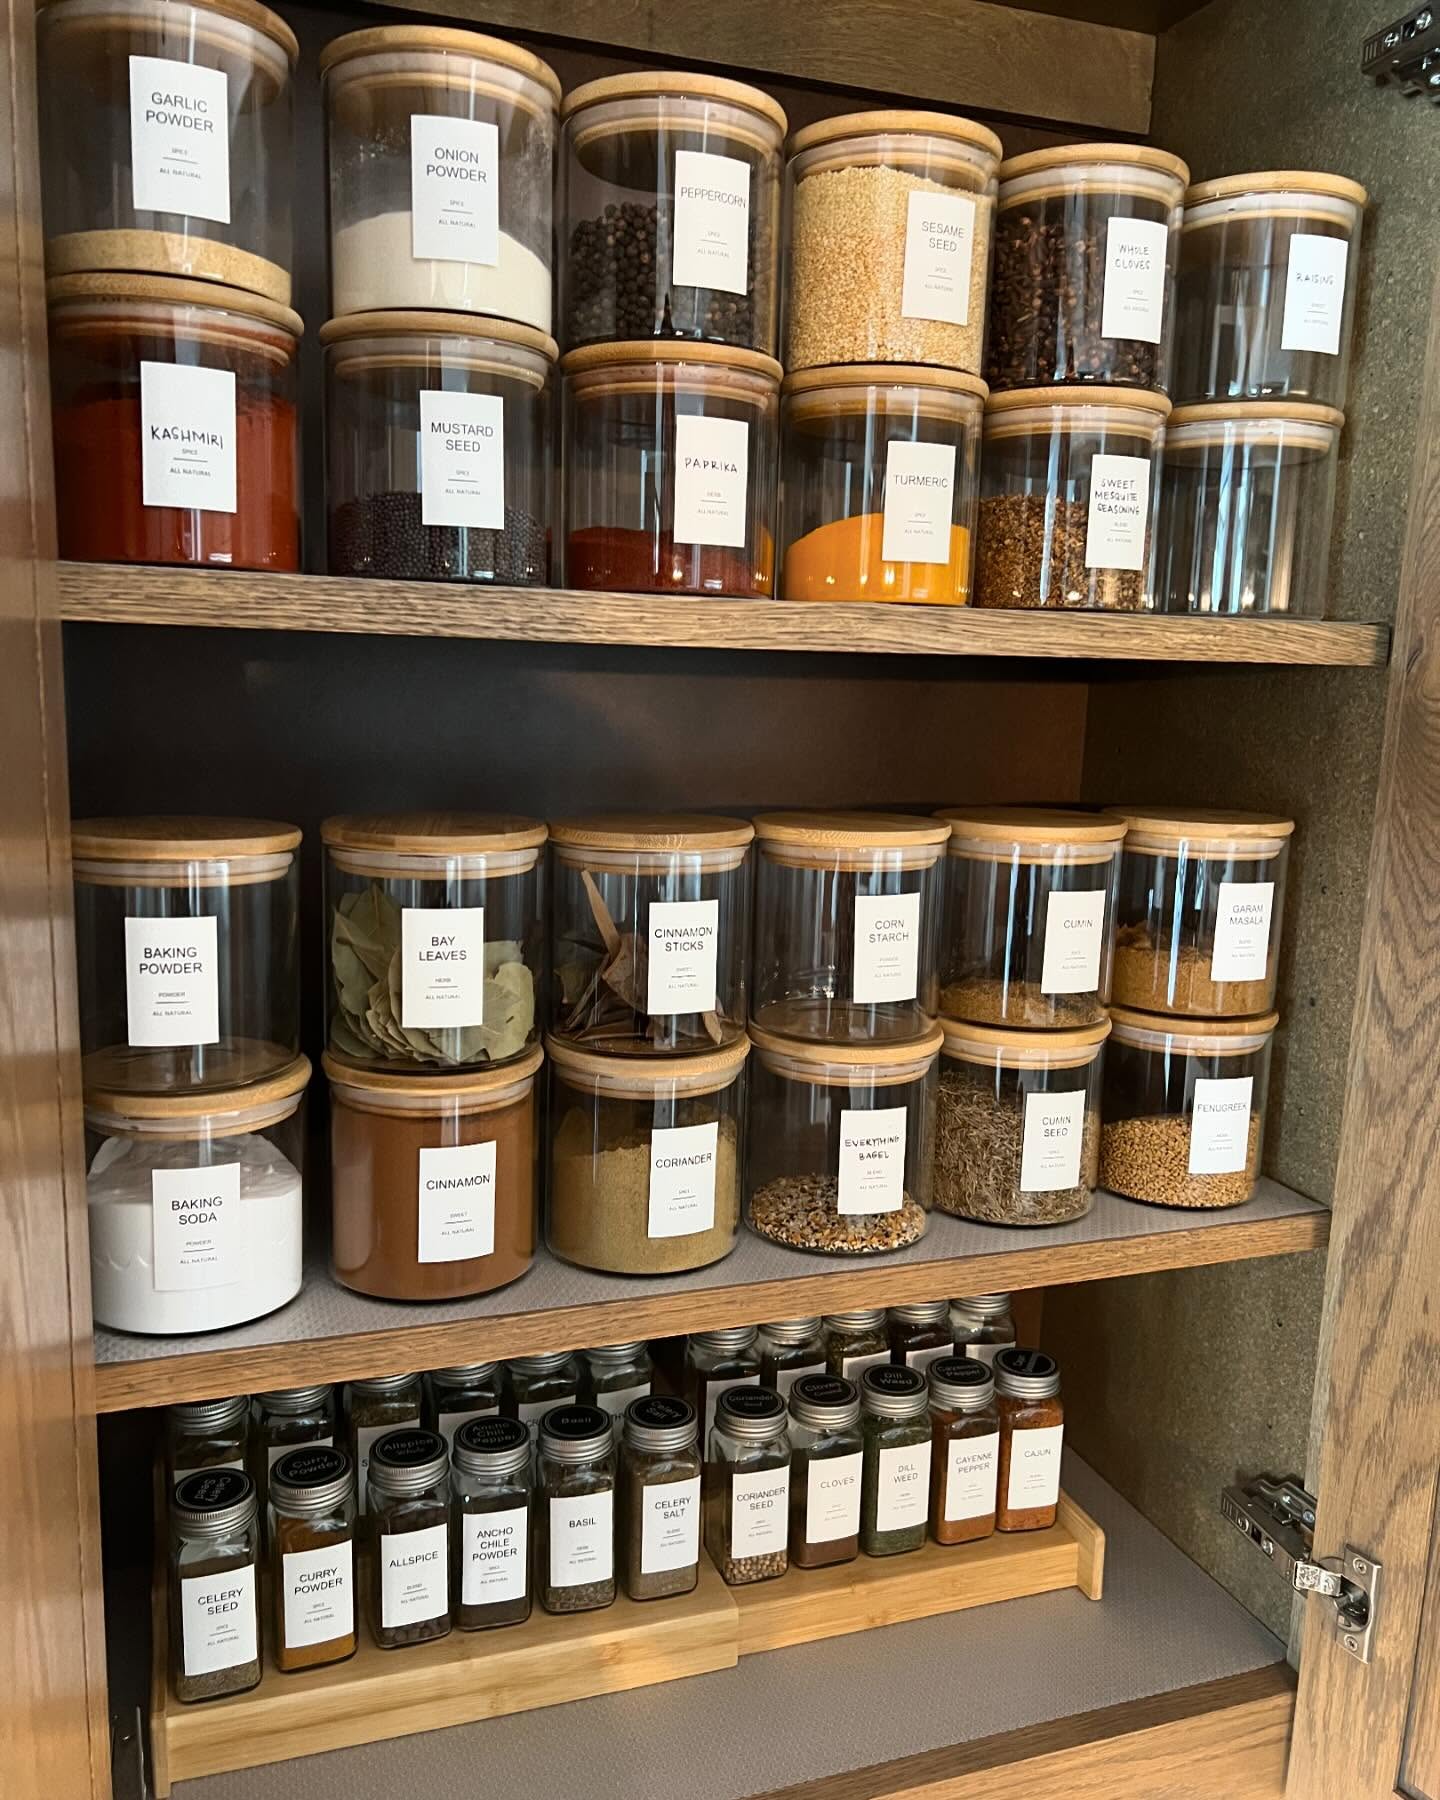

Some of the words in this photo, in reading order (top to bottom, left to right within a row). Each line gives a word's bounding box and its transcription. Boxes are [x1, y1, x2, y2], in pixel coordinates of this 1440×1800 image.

[151, 92, 207, 113] GARLIC
[146, 110, 213, 132] POWDER
[434, 147, 479, 164] ONION
[426, 164, 487, 182] POWDER
[681, 187, 746, 208] PEPPERCORN
[921, 221, 965, 238] SESAME
[929, 237, 957, 252] SEED
[1120, 244, 1149, 255] WHOLE
[1115, 258, 1150, 270] CLOVES
[431, 422, 493, 437] MUSTARD
[151, 425, 223, 449] KASHMIRI
[446, 439, 480, 452] SEED
[685, 457, 737, 473] PAPRIKA
[183, 469, 211, 477] NATURAL
[895, 474, 948, 488] TURMERIC
[1101, 479, 1135, 489] SWEET
[1095, 490, 1137, 501] MESQUITE
[1232, 904, 1263, 913] GARAM
[875, 919, 904, 930] CORN
[1063, 919, 1092, 929] CUMIN
[1229, 917, 1263, 925] MASALA
[654, 926, 712, 938] CINNAMON
[869, 932, 909, 943] STARCH
[431, 936, 455, 946] BAY
[665, 941, 704, 952] STICKS
[144, 946, 197, 958] BAKING
[419, 950, 467, 961] LEAVES
[139, 962, 202, 975] POWDER
[1197, 1103, 1247, 1112] FENUGREEK
[1042, 1116, 1071, 1125] CUMIN
[1044, 1127, 1068, 1137] SEED
[844, 1135, 900, 1147] EVERYTHING
[655, 1152, 712, 1168] CORIANDER
[859, 1151, 889, 1161] BAGEL
[426, 1173, 490, 1190] CINNAMON
[171, 1196, 222, 1210] BAKING
[178, 1212, 217, 1225] SODA
[383, 1438, 433, 1451] Allspice
[955, 1452, 992, 1464] CAYENNE
[1024, 1449, 1050, 1458] CAJUN
[292, 1455, 328, 1469] Curry
[898, 1464, 915, 1472] DILL
[958, 1462, 989, 1473] PEPPER
[289, 1460, 337, 1478] Powder
[820, 1476, 854, 1489] CLOVES
[893, 1472, 918, 1483] WEED
[736, 1486, 785, 1502] CORIANDER
[655, 1496, 691, 1510] CELERY
[749, 1500, 773, 1511] SEED
[663, 1508, 685, 1519] SALT
[569, 1517, 596, 1528] BASIL
[477, 1526, 513, 1539] ANCHO
[480, 1538, 510, 1549] CHILE
[390, 1550, 438, 1568] ALLSPICE
[472, 1548, 517, 1560] POWDER
[299, 1567, 337, 1583] CURRY
[294, 1577, 342, 1595] POWDER
[198, 1587, 243, 1605] CELERY
[207, 1601, 238, 1615] SEED
